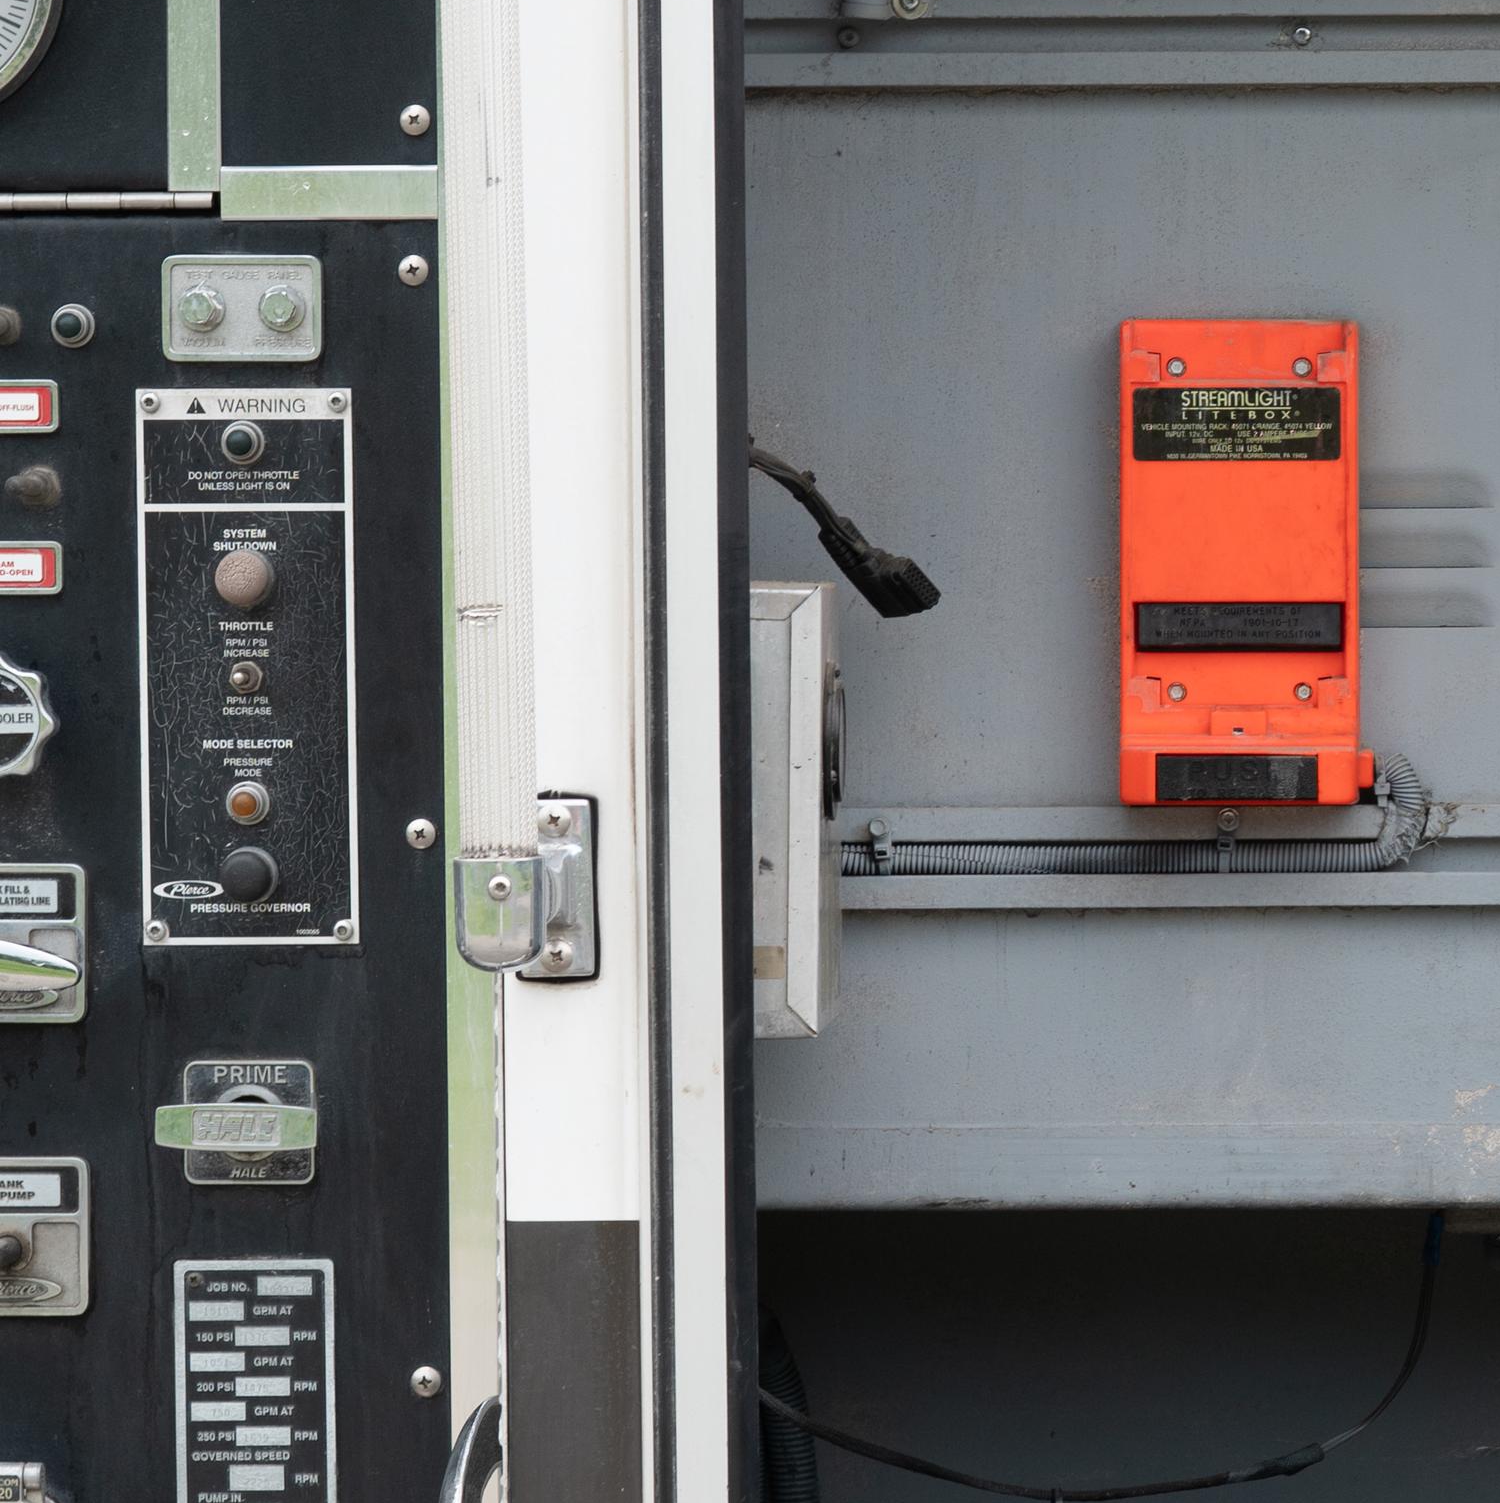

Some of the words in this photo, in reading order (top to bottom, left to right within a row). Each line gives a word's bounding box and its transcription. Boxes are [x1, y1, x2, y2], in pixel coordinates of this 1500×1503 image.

[186, 269, 213, 279] TEST
[1181, 390, 1292, 407] STREAMLIGHT
[217, 398, 306, 414] WARNING
[1141, 423, 1170, 431] VEHICLE
[1171, 423, 1208, 431] MOUNTING
[1305, 422, 1333, 430] YELLOW
[1237, 430, 1252, 438] USE
[1210, 444, 1233, 452] MADE
[1235, 444, 1244, 452] IN
[1246, 444, 1263, 452] USA
[188, 471, 203, 480] DO
[204, 471, 223, 480] NOT
[225, 471, 252, 479] OPEN
[252, 471, 300, 479] THROTTLE
[198, 482, 235, 491] UNLESS
[236, 482, 263, 490] LIGHT
[265, 482, 275, 490] IS
[276, 482, 290, 490] ON
[223, 529, 267, 539] SYSTEM
[213, 541, 277, 551] SHUT-DOWN
[1174, 607, 1208, 616] MEETS
[219, 622, 274, 631] THROTTLE
[1179, 618, 1206, 627] NFPA
[1155, 630, 1182, 639] WHEN
[1187, 630, 1233, 639] MOUNTED
[1238, 630, 1248, 639] IN
[1251, 630, 1270, 639] ANY
[1275, 630, 1321, 639] POSITION
[225, 638, 246, 647] RPM
[252, 638, 267, 646] PSI
[224, 649, 270, 658] INCREASE
[226, 696, 247, 705] RPM
[253, 696, 269, 705] PSI
[222, 707, 272, 716] DECREASE
[202, 739, 235, 749] MODE
[236, 739, 293, 749] SELECTOR
[223, 757, 273, 766] PRESSURE
[234, 768, 262, 777] MODE
[4, 885, 22, 895] FILL
[23, 885, 30, 895] &
[170, 882, 210, 896] Pierce
[31, 896, 51, 906] LINE
[190, 903, 248, 913] PRESSURE
[250, 902, 311, 913] GOVERNOR
[213, 1065, 287, 1084] PRIME
[198, 1113, 277, 1142] HALE
[230, 1167, 267, 1179] HALE
[206, 1282, 228, 1292] JOB
[253, 1305, 277, 1316] GPM
[279, 1305, 293, 1315] AT
[196, 1332, 214, 1343] 150
[216, 1332, 233, 1342] PSI
[293, 1331, 317, 1341] RPM
[254, 1356, 277, 1367] GPM
[280, 1356, 294, 1366] AT
[196, 1382, 214, 1393] 200
[217, 1382, 234, 1392] PSI
[294, 1381, 317, 1391] RPM
[254, 1406, 278, 1417] GPM
[280, 1406, 294, 1416] AT
[197, 1431, 216, 1442] 250
[218, 1431, 234, 1441] PSI
[294, 1431, 318, 1441] RPM
[191, 1451, 251, 1462] GOVERNED
[254, 1451, 290, 1461] SPEED
[295, 1473, 318, 1484] RPM
[198, 1493, 228, 1503] PUMP
